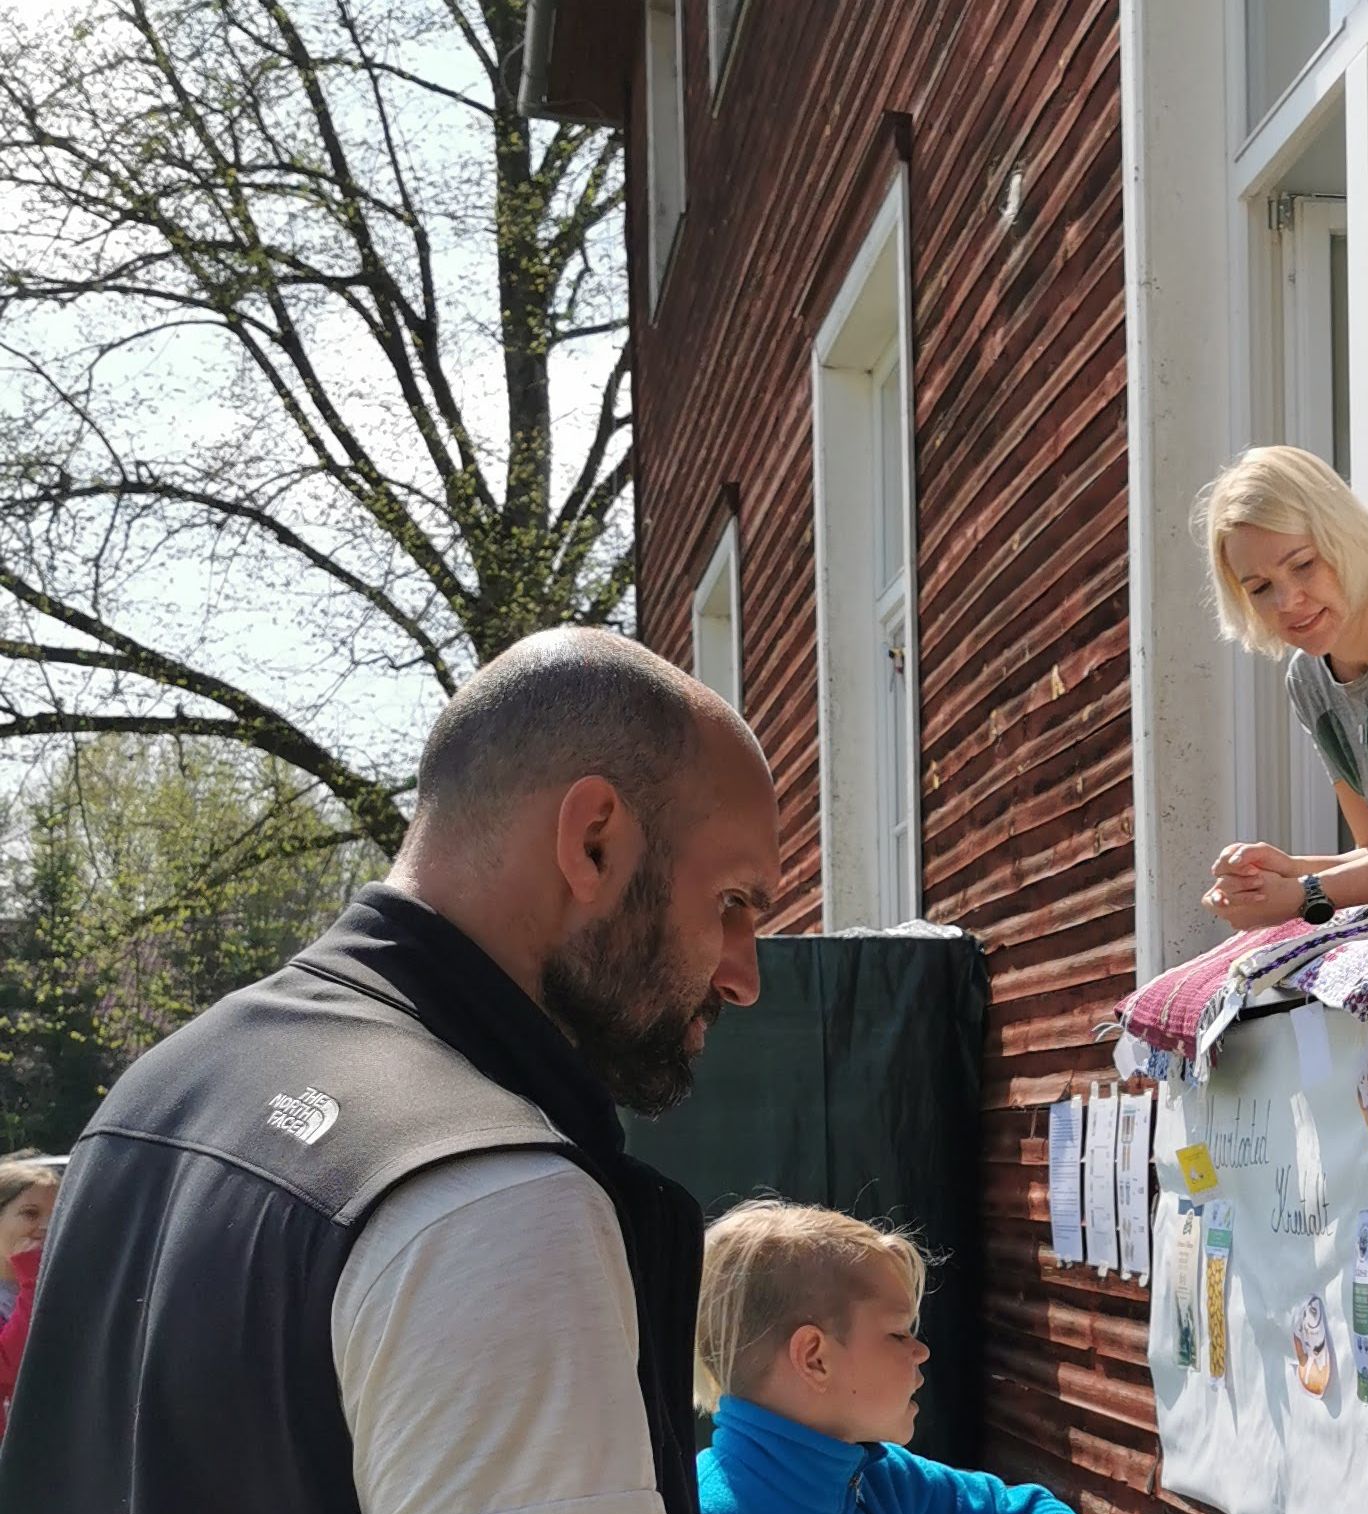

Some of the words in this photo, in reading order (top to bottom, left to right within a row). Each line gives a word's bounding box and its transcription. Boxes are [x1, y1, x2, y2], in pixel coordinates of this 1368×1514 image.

[268, 1093, 314, 1121] NORTH
[299, 1086, 329, 1108] THE
[267, 1110, 305, 1135] FACE
